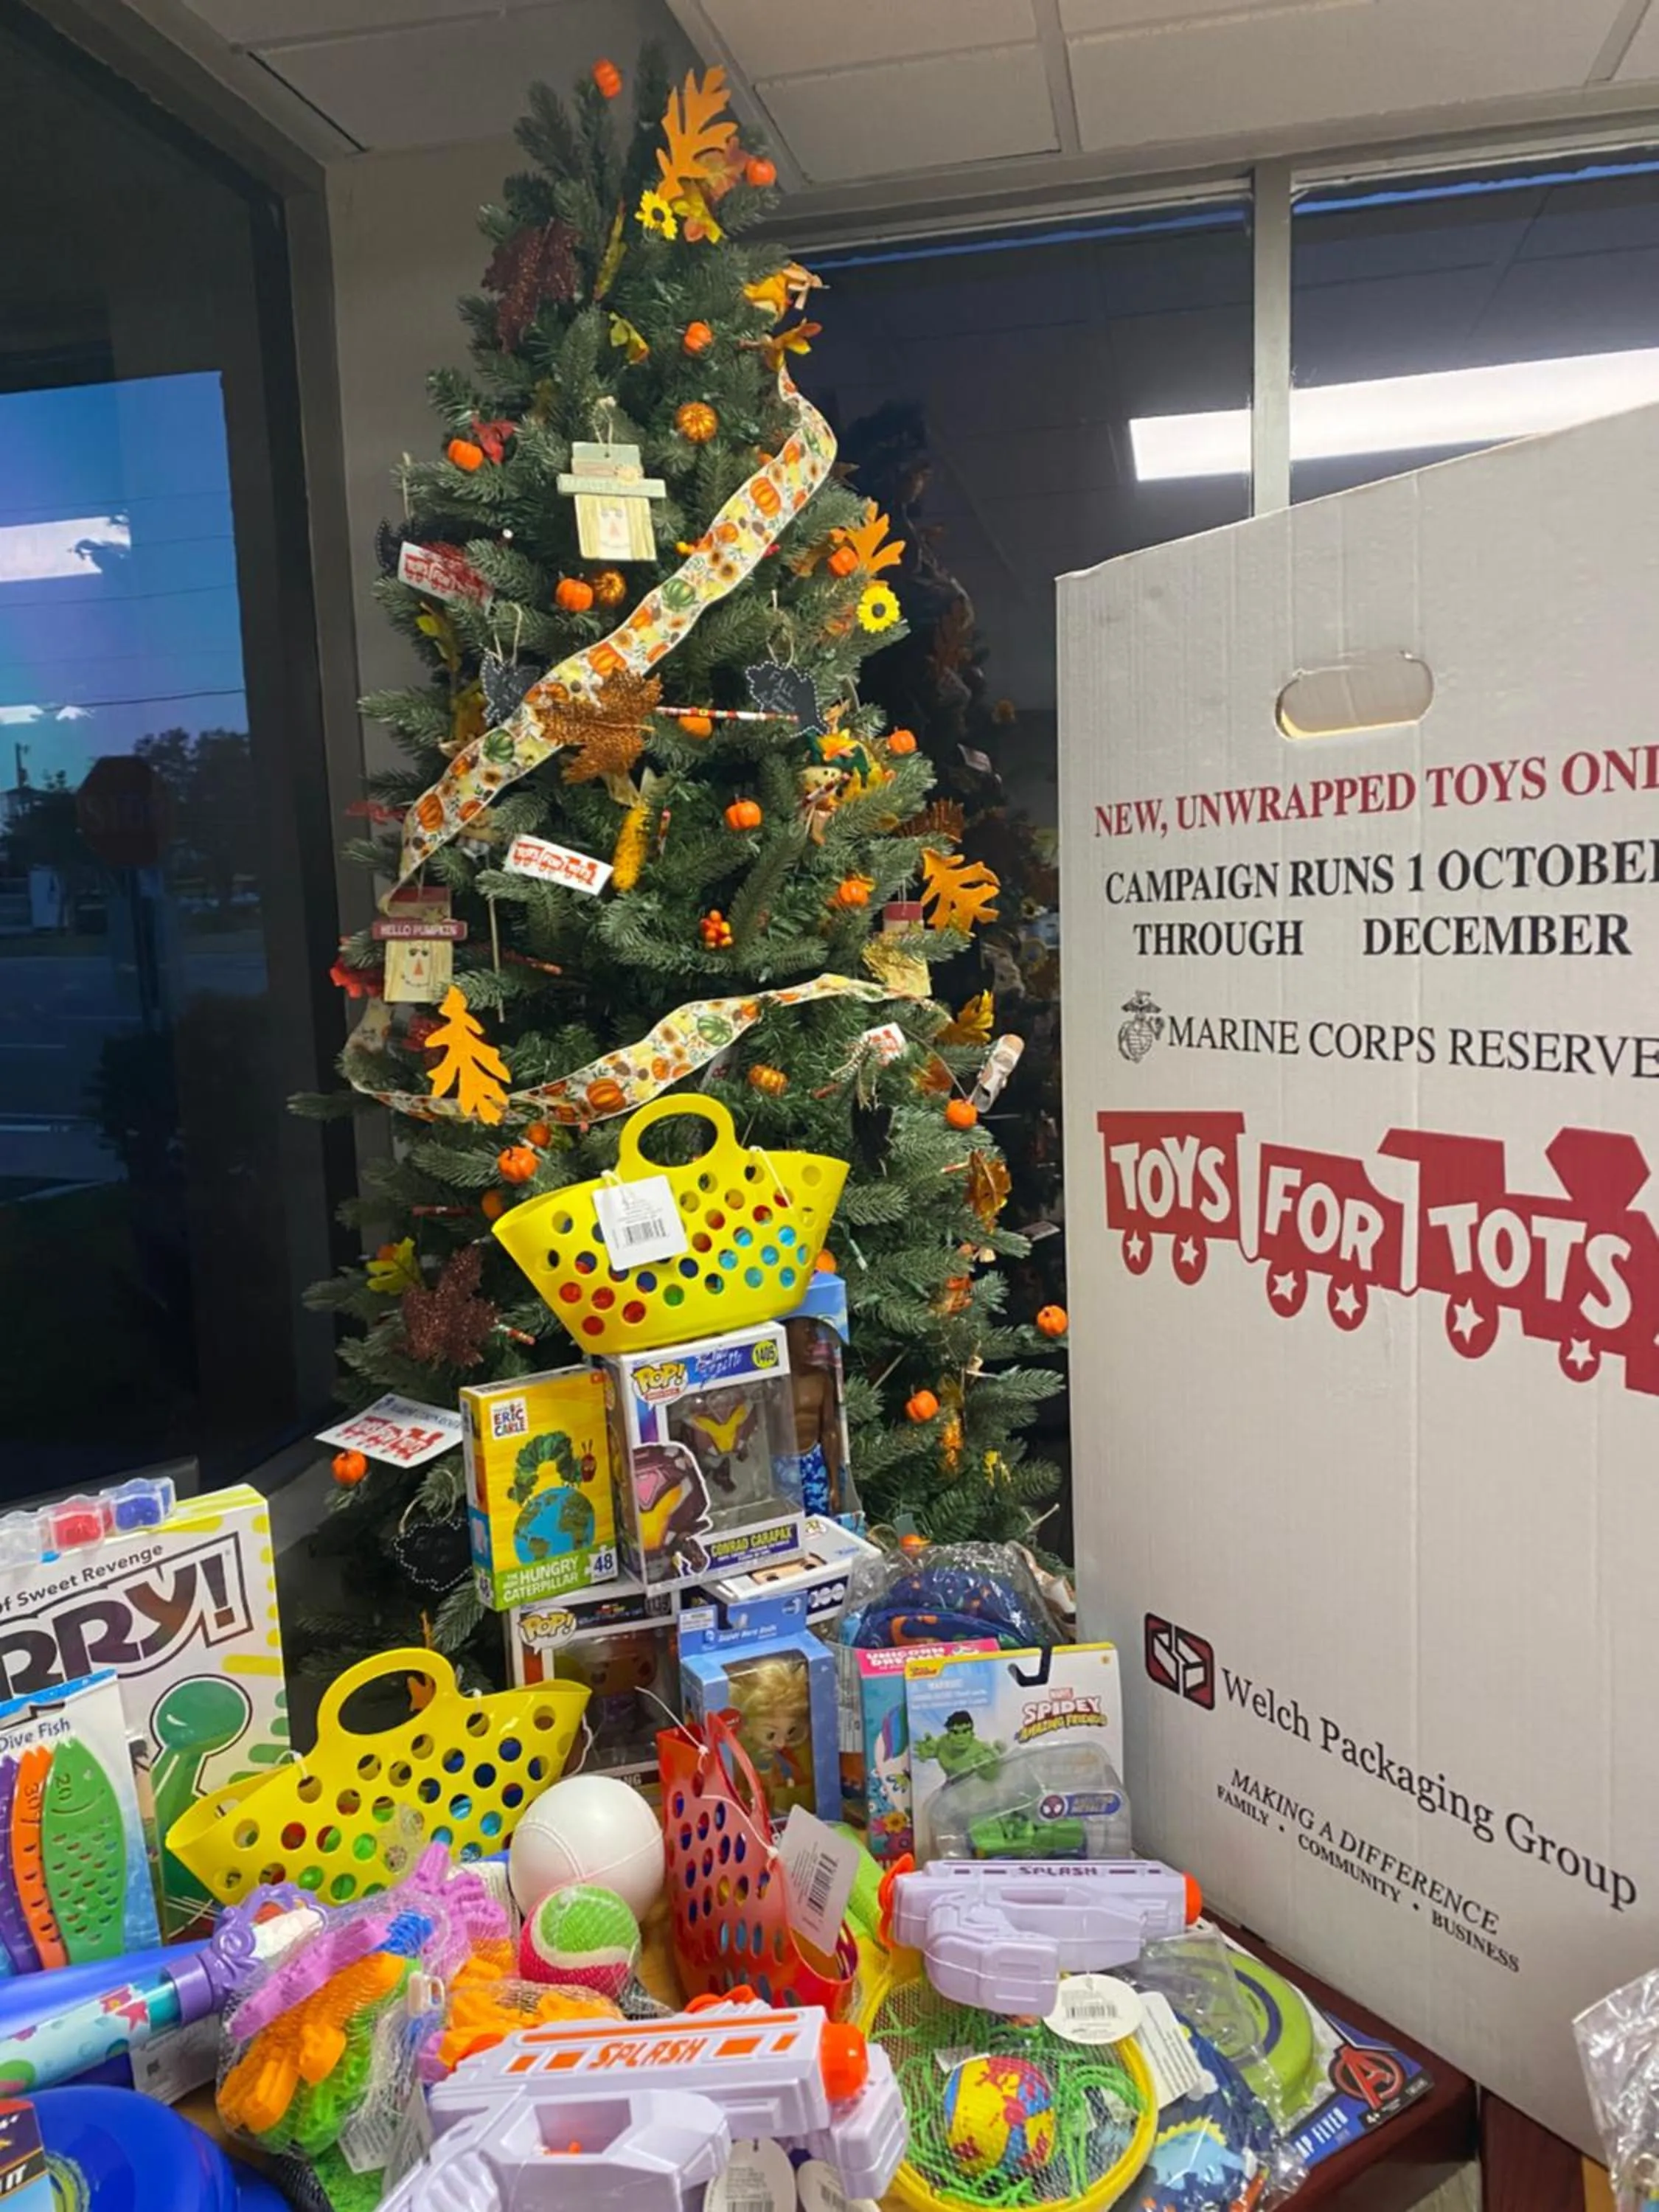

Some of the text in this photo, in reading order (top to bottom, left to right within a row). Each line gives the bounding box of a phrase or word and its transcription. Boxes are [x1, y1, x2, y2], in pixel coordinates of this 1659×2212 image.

[1094, 799, 1168, 838] NEW,
[1176, 771, 1416, 830] UNWRAPPED
[1425, 757, 1547, 809] TOYS
[1105, 862, 1279, 905] CAMPAIGN
[1290, 854, 1394, 897] RUNS
[1408, 853, 1423, 893] 1
[380, 923, 411, 936] HELLO
[1133, 913, 1632, 956] THROUGH DECEMBER
[1169, 1015, 1659, 1079] MARINE CORPS RESERVE
[1110, 1134, 1633, 1329] TOYS FOR TOTS
[631, 1361, 685, 1396] POP!
[18, 1577, 78, 1608] Sweet
[81, 1543, 164, 1582] Revenge
[520, 1556, 579, 1585] HUNGRY
[593, 1553, 613, 1573] 48
[503, 1572, 578, 1603] CATERPILLAR
[518, 1613, 575, 1643] POP!
[866, 1646, 945, 1660] UNICORN
[38, 1717, 71, 1738] Fish
[1023, 1696, 1101, 1726] SPIDEY
[1222, 1667, 1638, 1911] Welch Packaging Group
[1231, 1769, 1500, 1935] MAKING A DIFFERENCE
[1019, 1867, 1098, 1877] SPLASH
[1217, 1784, 1520, 1974] FAMILY COMMUNITY BUSINESS
[586, 2037, 709, 2070] SPLASH
